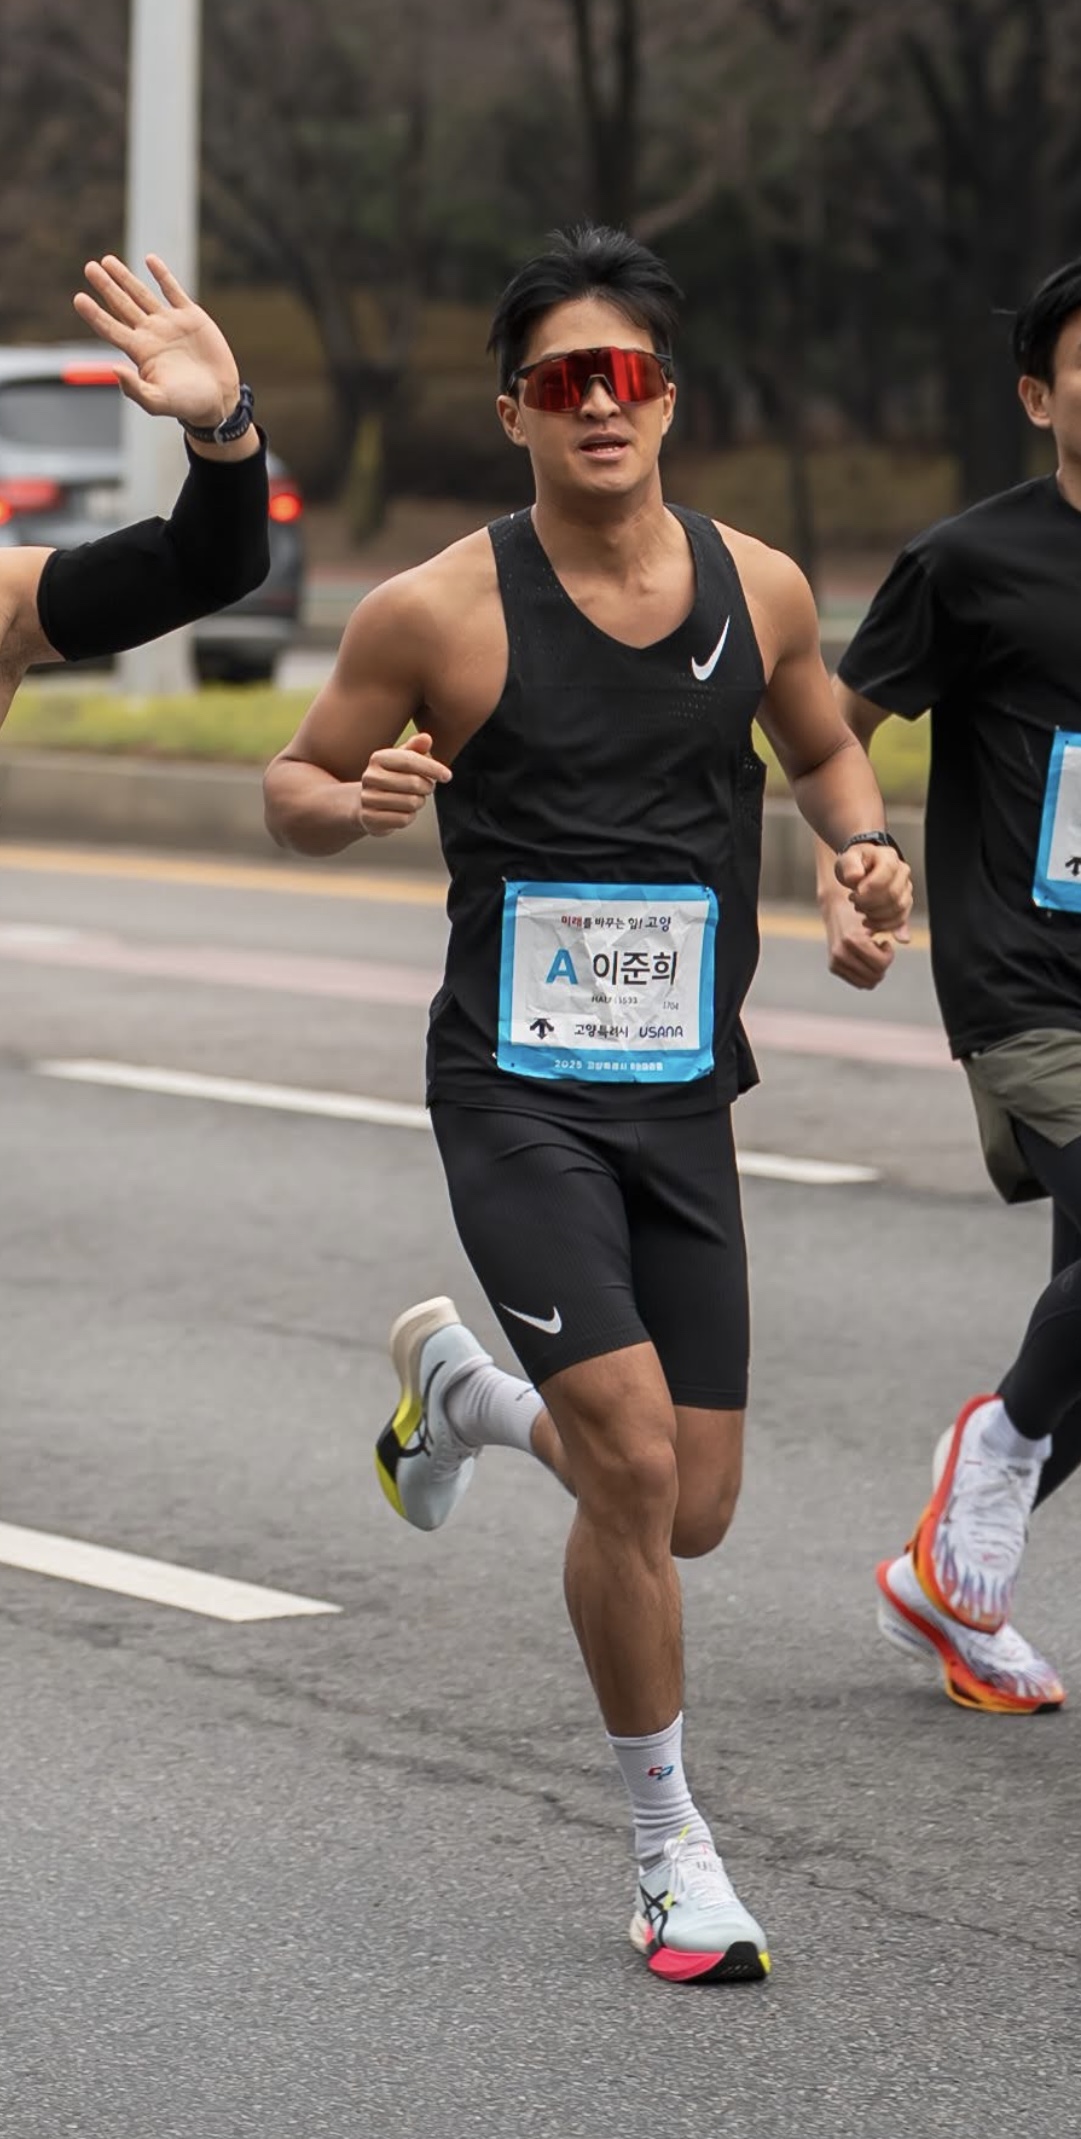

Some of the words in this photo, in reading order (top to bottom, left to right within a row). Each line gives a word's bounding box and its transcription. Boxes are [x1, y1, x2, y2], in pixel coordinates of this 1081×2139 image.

[645, 916, 671, 932] 고양
[546, 948, 578, 985] A
[593, 951, 678, 985] 이준희
[639, 1026, 684, 1038] USANA
